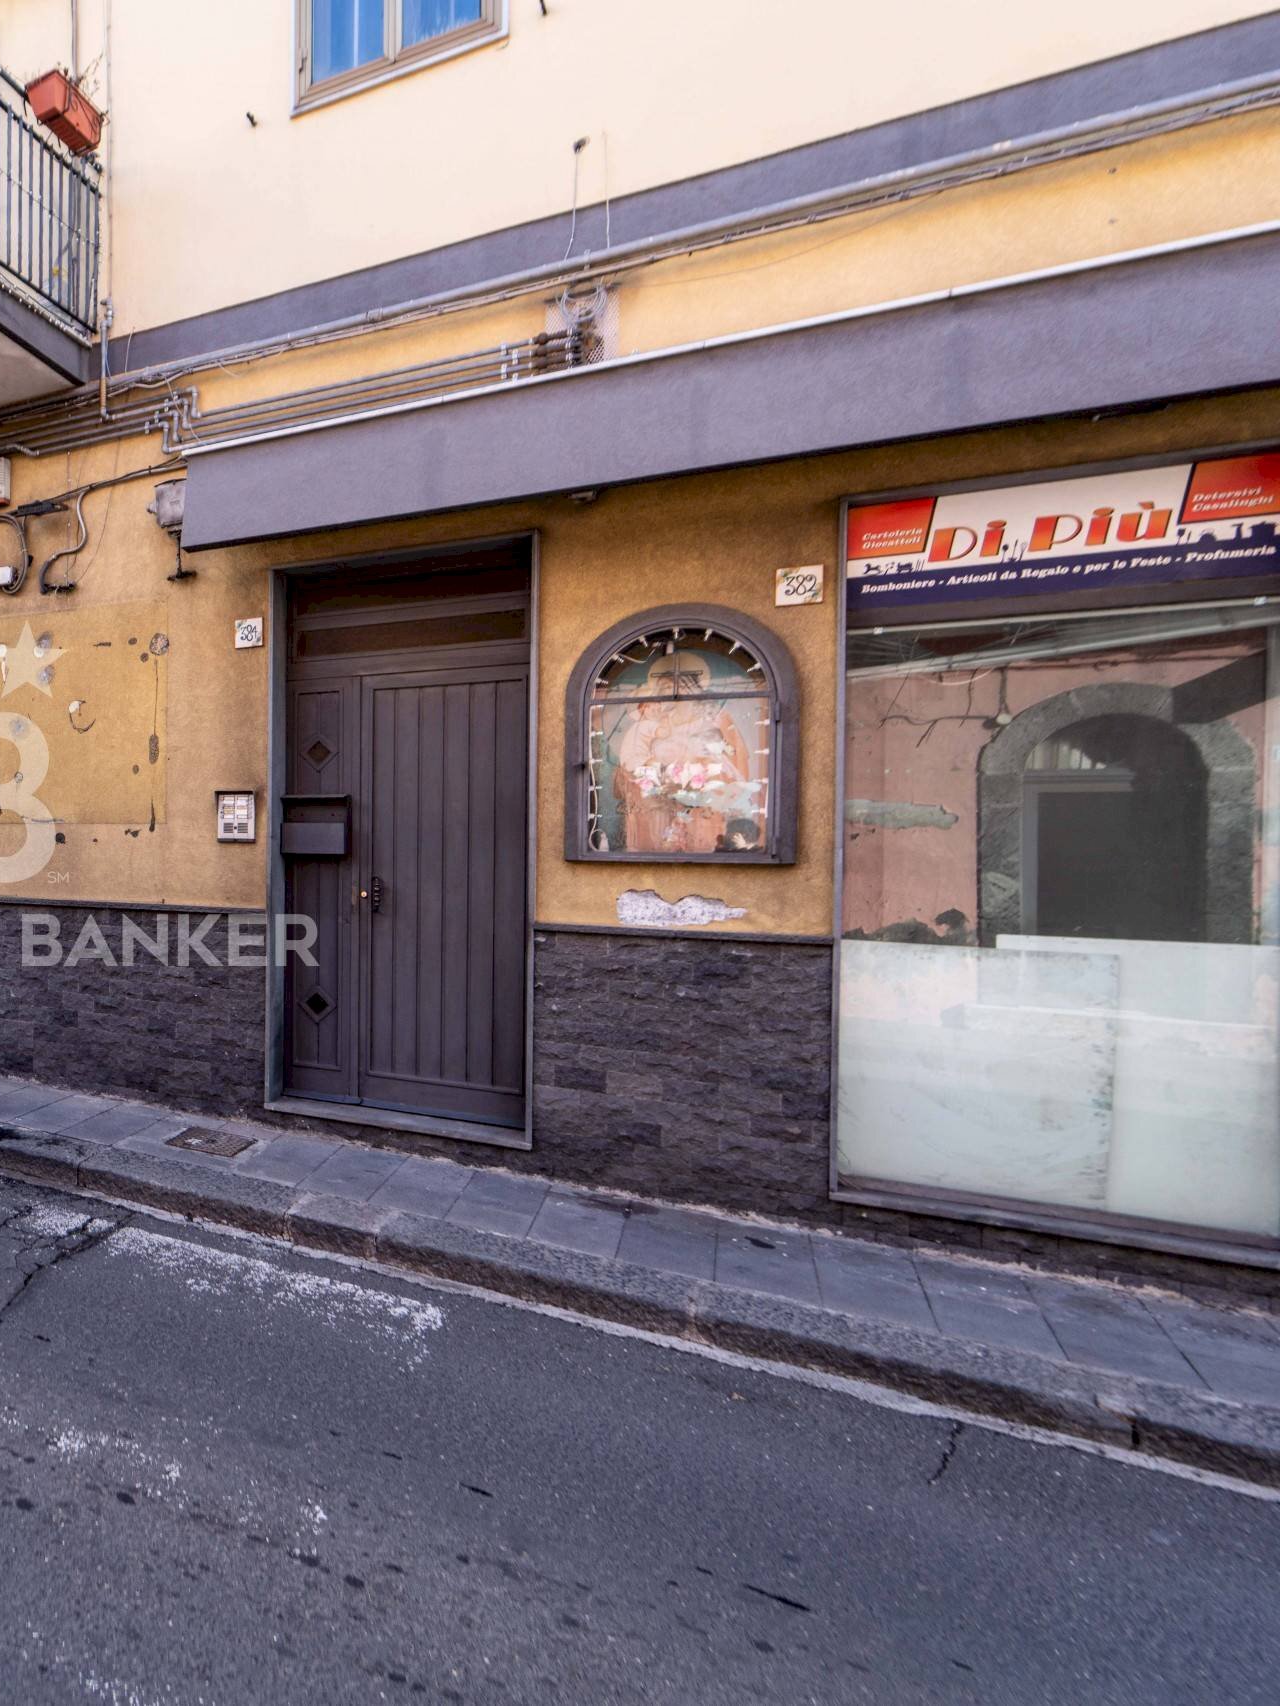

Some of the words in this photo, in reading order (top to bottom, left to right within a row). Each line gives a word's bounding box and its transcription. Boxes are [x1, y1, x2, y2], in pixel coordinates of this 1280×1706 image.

[1192, 487, 1262, 503] Detersivi
[1192, 495, 1274, 512] Casalinghi
[862, 528, 923, 541] Cartoleria
[928, 519, 1007, 563] Di
[1028, 501, 1172, 552] Più
[862, 536, 921, 549] Giocattoli
[861, 579, 936, 594] Bomboniere
[946, 571, 997, 586] Articoli
[1000, 569, 1018, 580] da
[1020, 564, 1069, 579] Regalo
[1072, 563, 1081, 574] e
[1084, 562, 1109, 575] per
[1113, 558, 1126, 570] le
[1130, 555, 1171, 569] Feste
[1184, 545, 1276, 562] Profumeria
[784, 574, 817, 597] 382
[240, 624, 257, 642] 384
